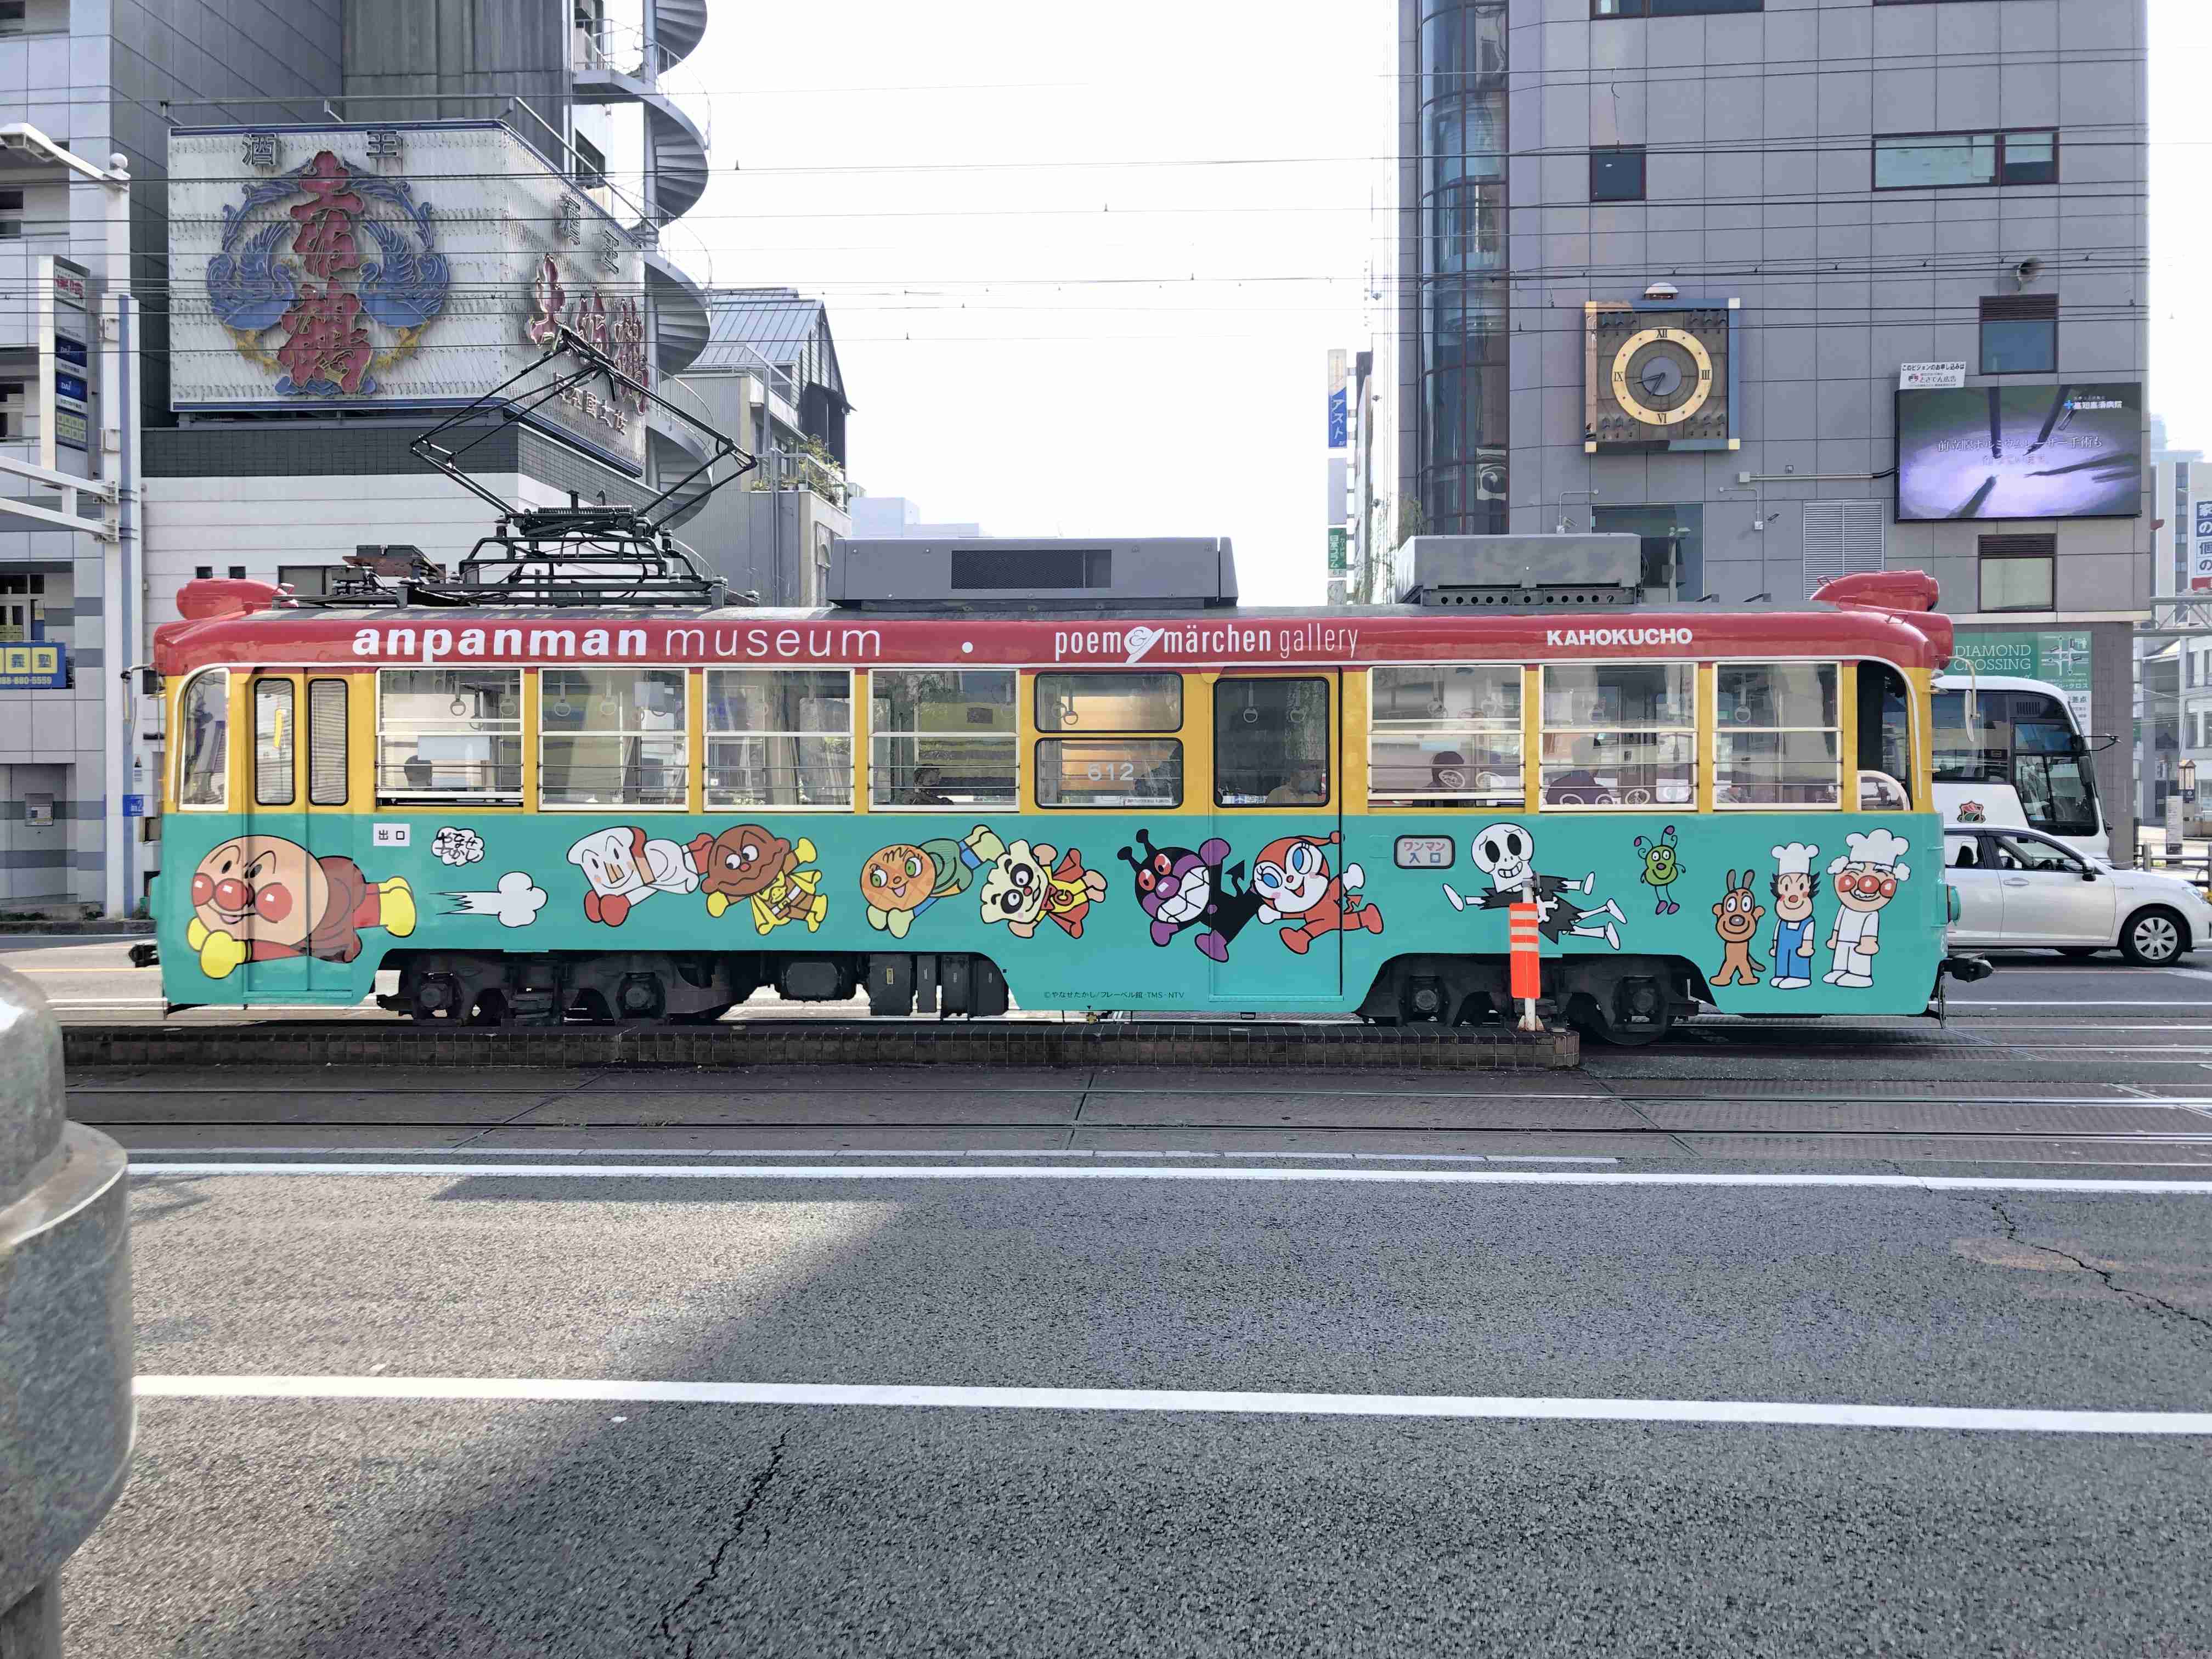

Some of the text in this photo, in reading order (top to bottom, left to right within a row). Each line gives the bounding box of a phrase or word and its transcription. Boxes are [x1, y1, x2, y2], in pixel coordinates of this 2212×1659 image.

[1656, 329, 1668, 338] XII
[1613, 371, 1624, 382] IX
[1702, 369, 1710, 380] III
[1657, 414, 1667, 423] VI
[1055, 630, 1121, 662] poem
[1164, 624, 1271, 653] märchen
[1280, 623, 1358, 658] gallery
[1547, 628, 1693, 646] KAHOKUCHO
[352, 628, 881, 663] anpanman museum
[1955, 645, 2031, 657] DIAMOND
[1088, 762, 1134, 781] 612
[378, 829, 405, 840] 出口
[437, 832, 478, 851] やなせ
[1404, 841, 1446, 851] ワンマン
[1408, 852, 1441, 864] 入口
